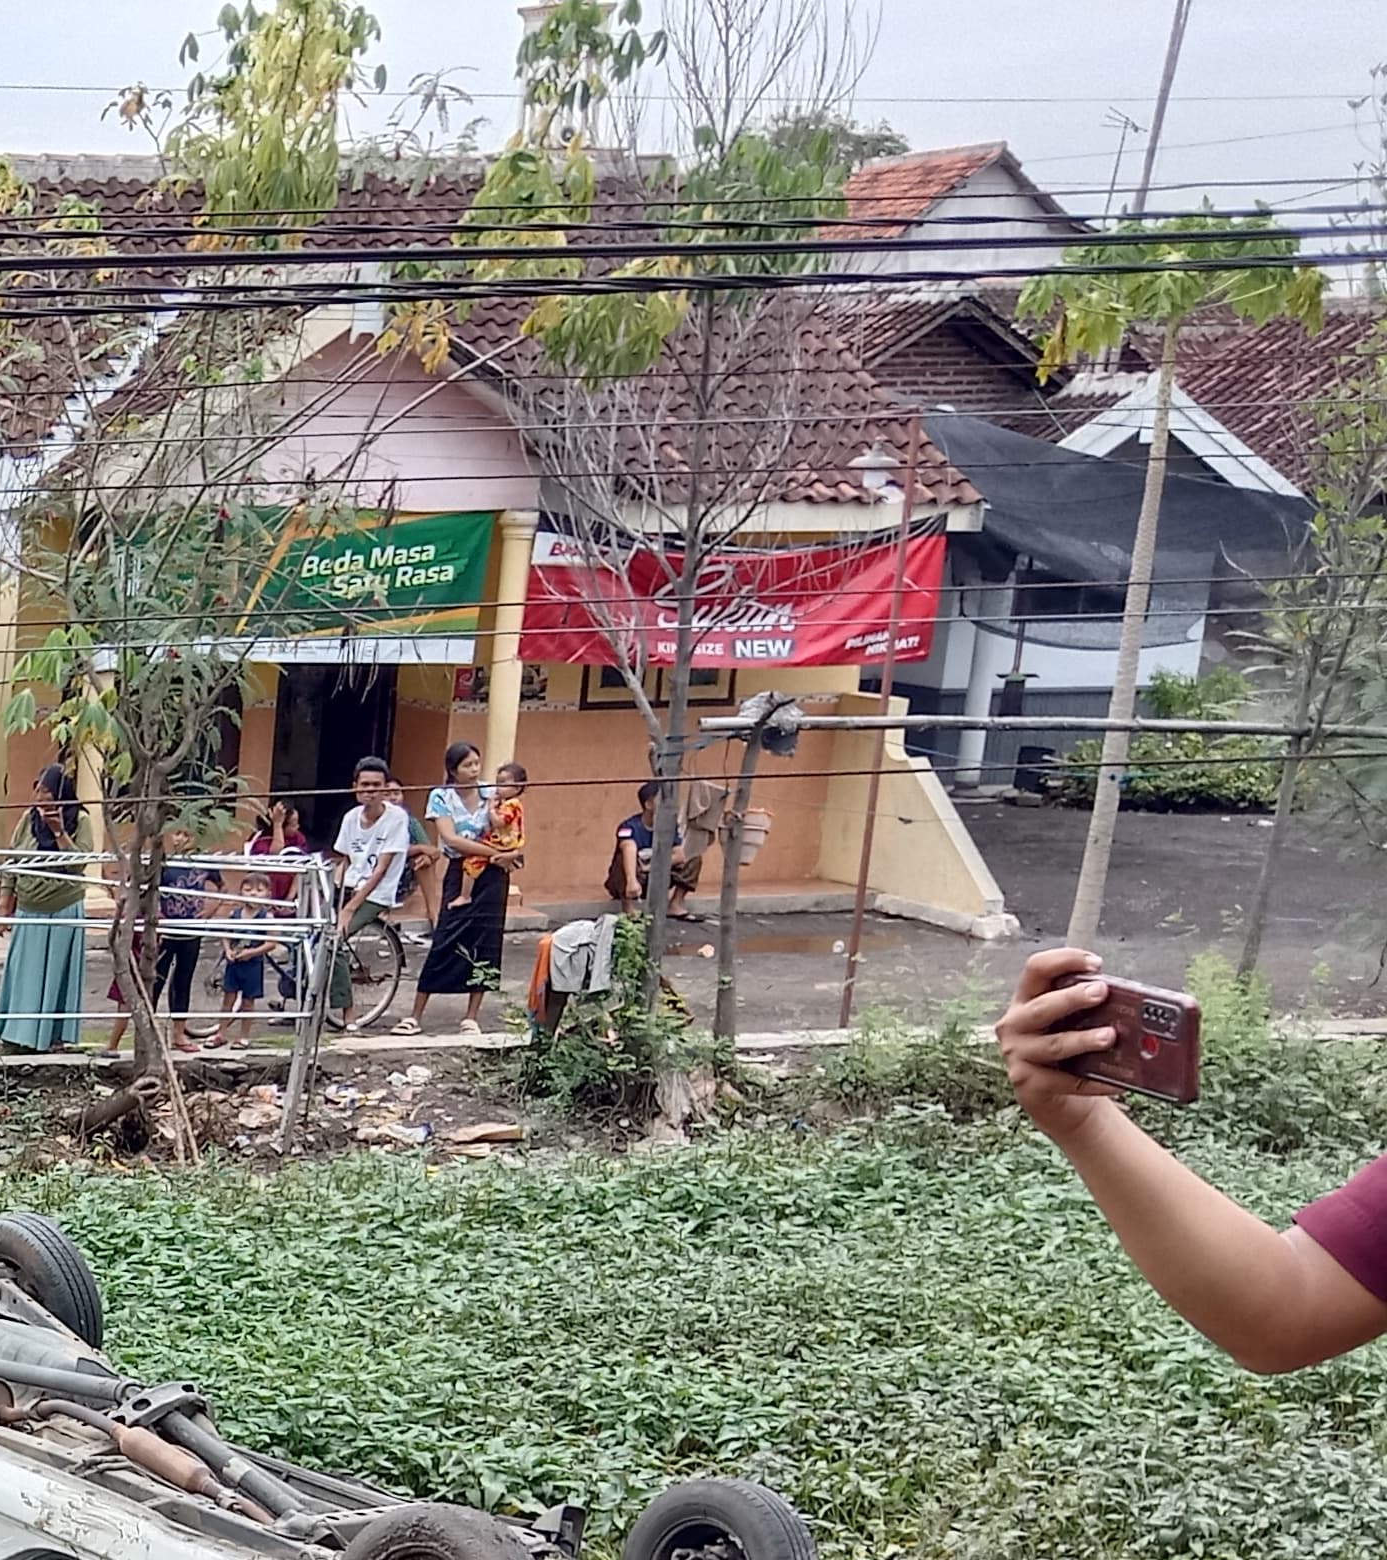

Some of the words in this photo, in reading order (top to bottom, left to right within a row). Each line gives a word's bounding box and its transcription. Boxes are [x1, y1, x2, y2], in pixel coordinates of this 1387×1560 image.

[301, 549, 365, 578] Beda
[369, 544, 436, 568] Masa
[394, 564, 455, 588] Rasa
[694, 642, 724, 655] SIZE
[734, 639, 792, 658] NEW
[844, 630, 891, 650] PILIHA
